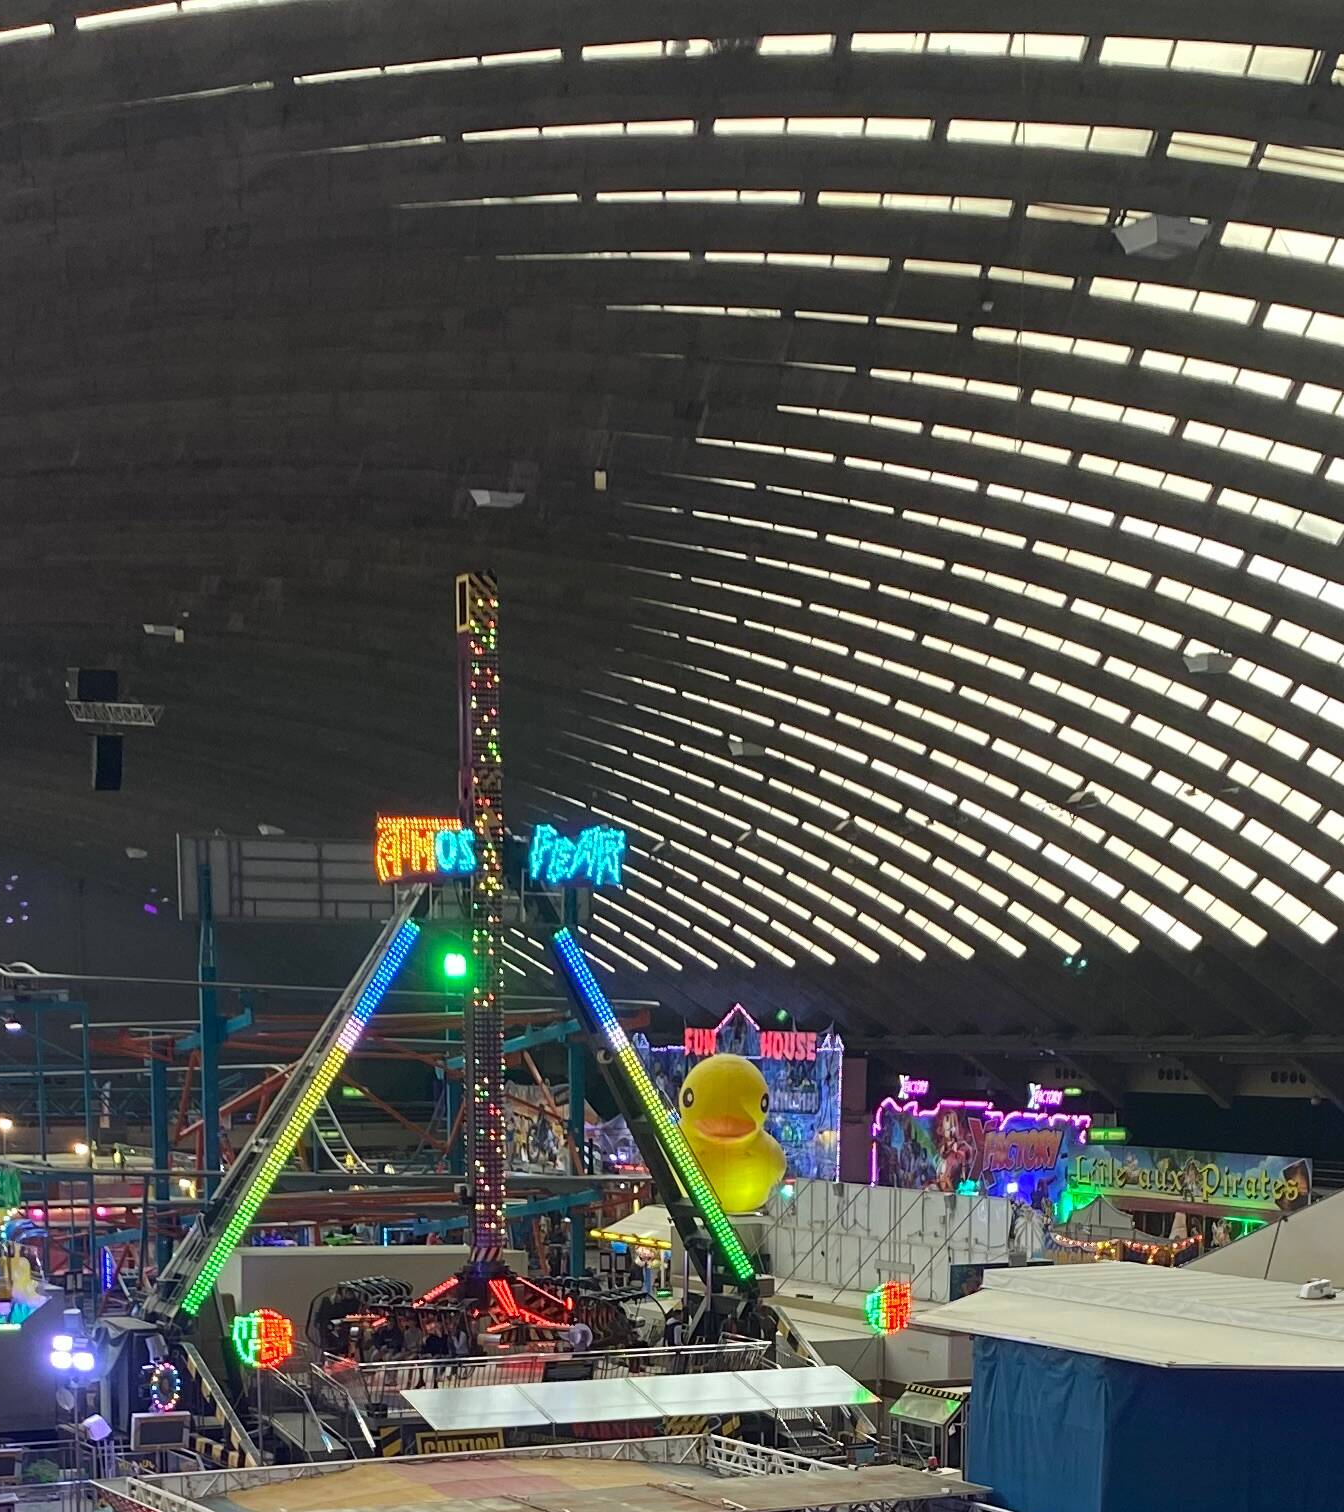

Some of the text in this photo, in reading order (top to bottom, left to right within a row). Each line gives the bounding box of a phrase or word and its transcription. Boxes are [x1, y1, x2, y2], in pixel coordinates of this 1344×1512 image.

[685, 1027, 817, 1061] FUN HOUSE
[1199, 1163, 1299, 1201] Pirates
[423, 1437, 499, 1454] CAUTION
